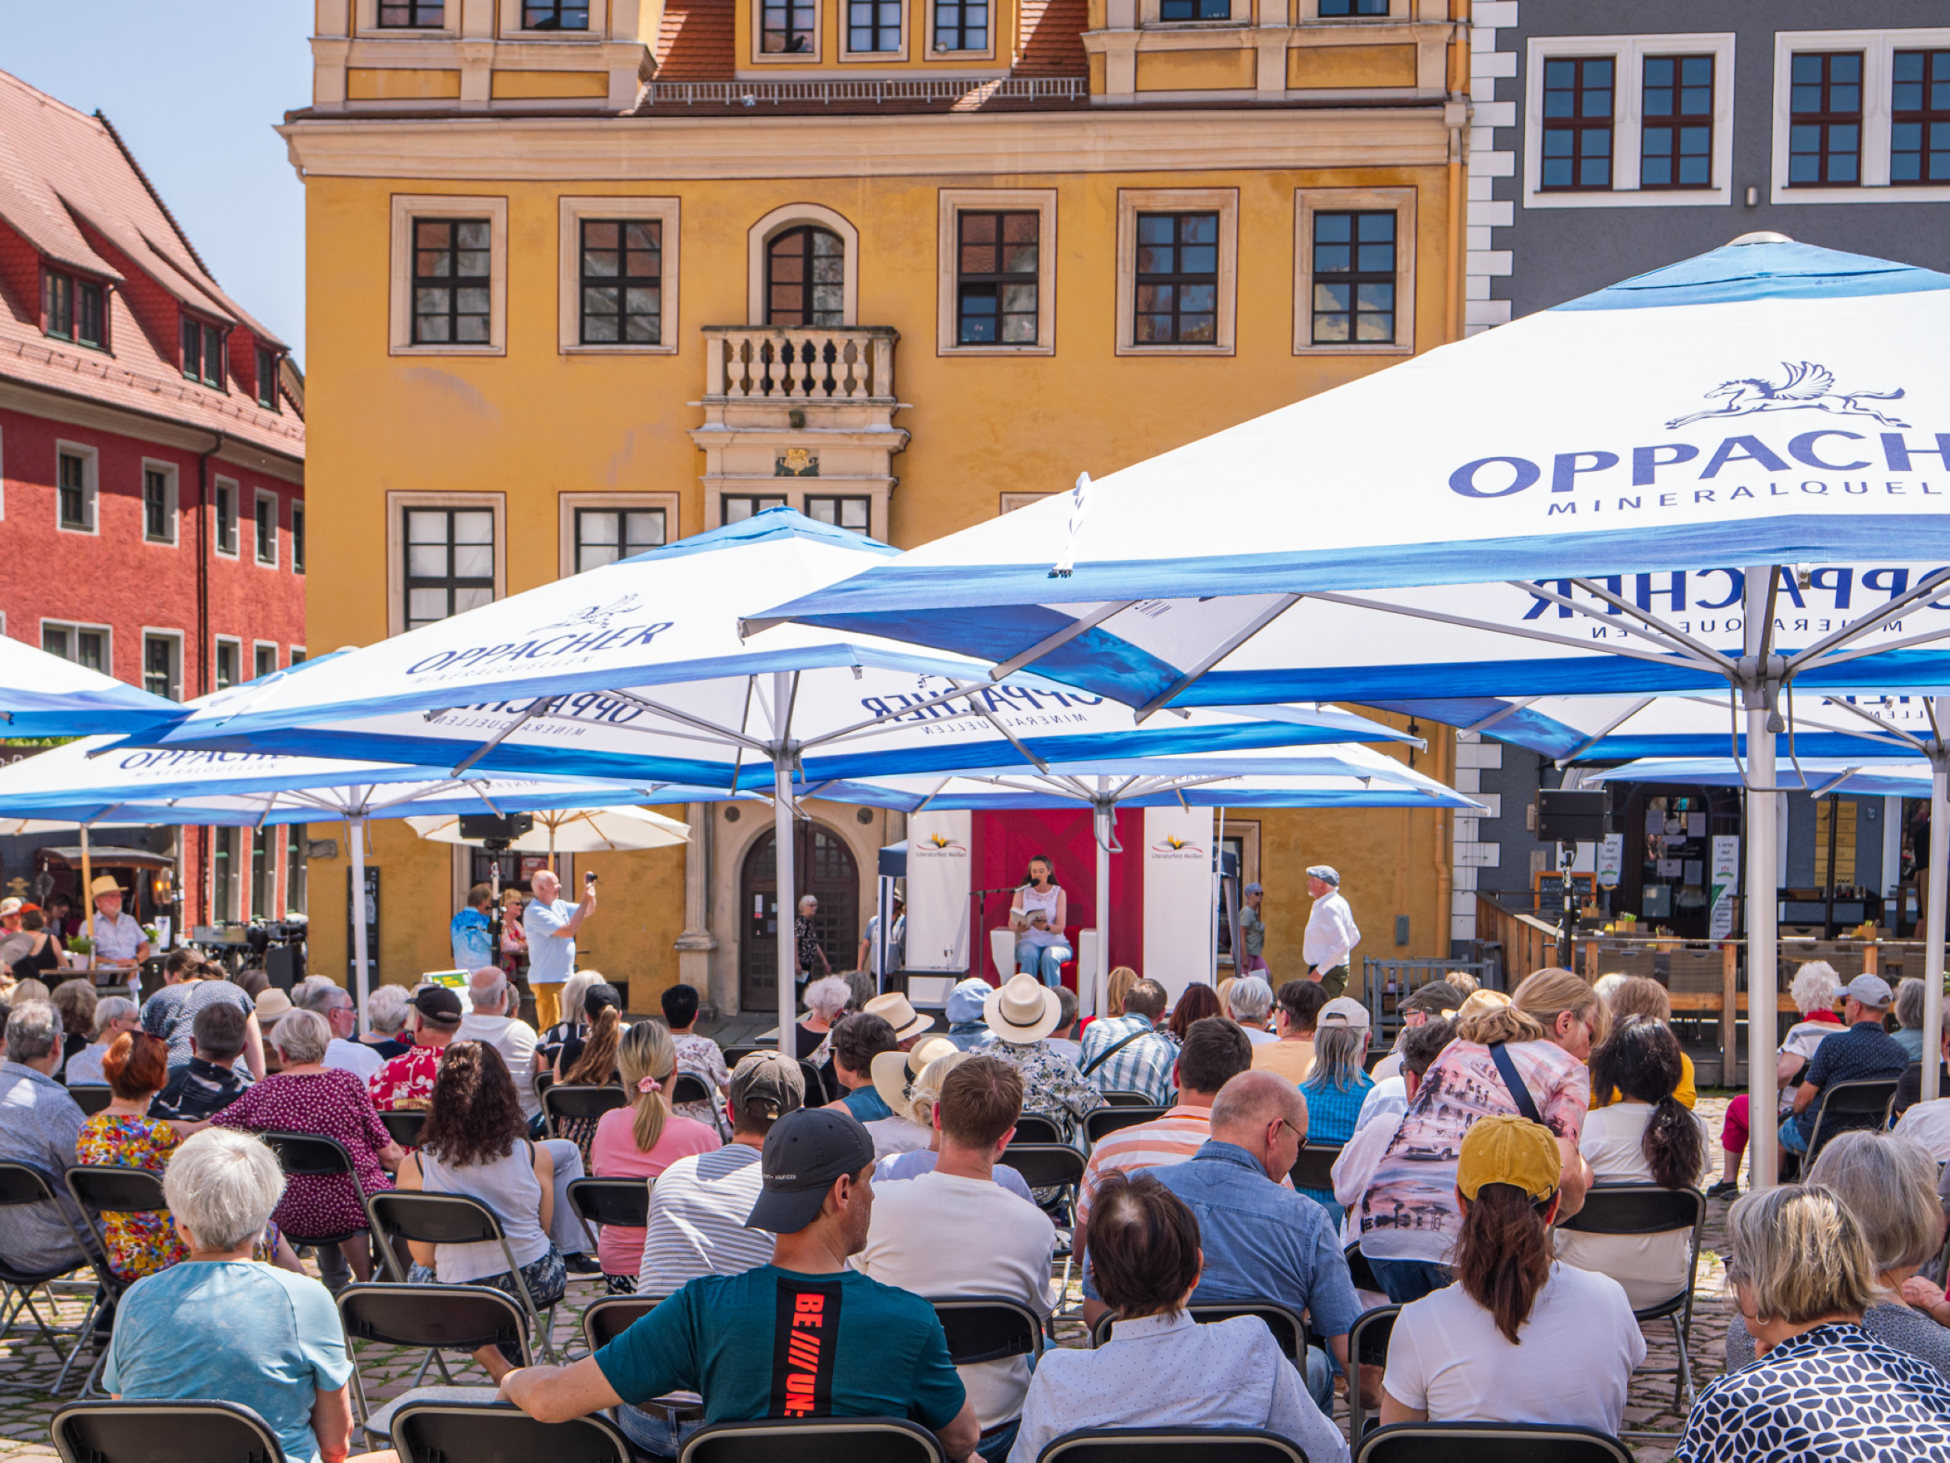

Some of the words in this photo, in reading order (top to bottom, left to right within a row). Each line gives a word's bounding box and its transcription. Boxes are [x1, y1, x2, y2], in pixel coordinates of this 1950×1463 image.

[1448, 429, 1950, 499] OPPACH
[1547, 480, 1943, 516] MINERALQUEL
[405, 621, 675, 675] OPPACHER
